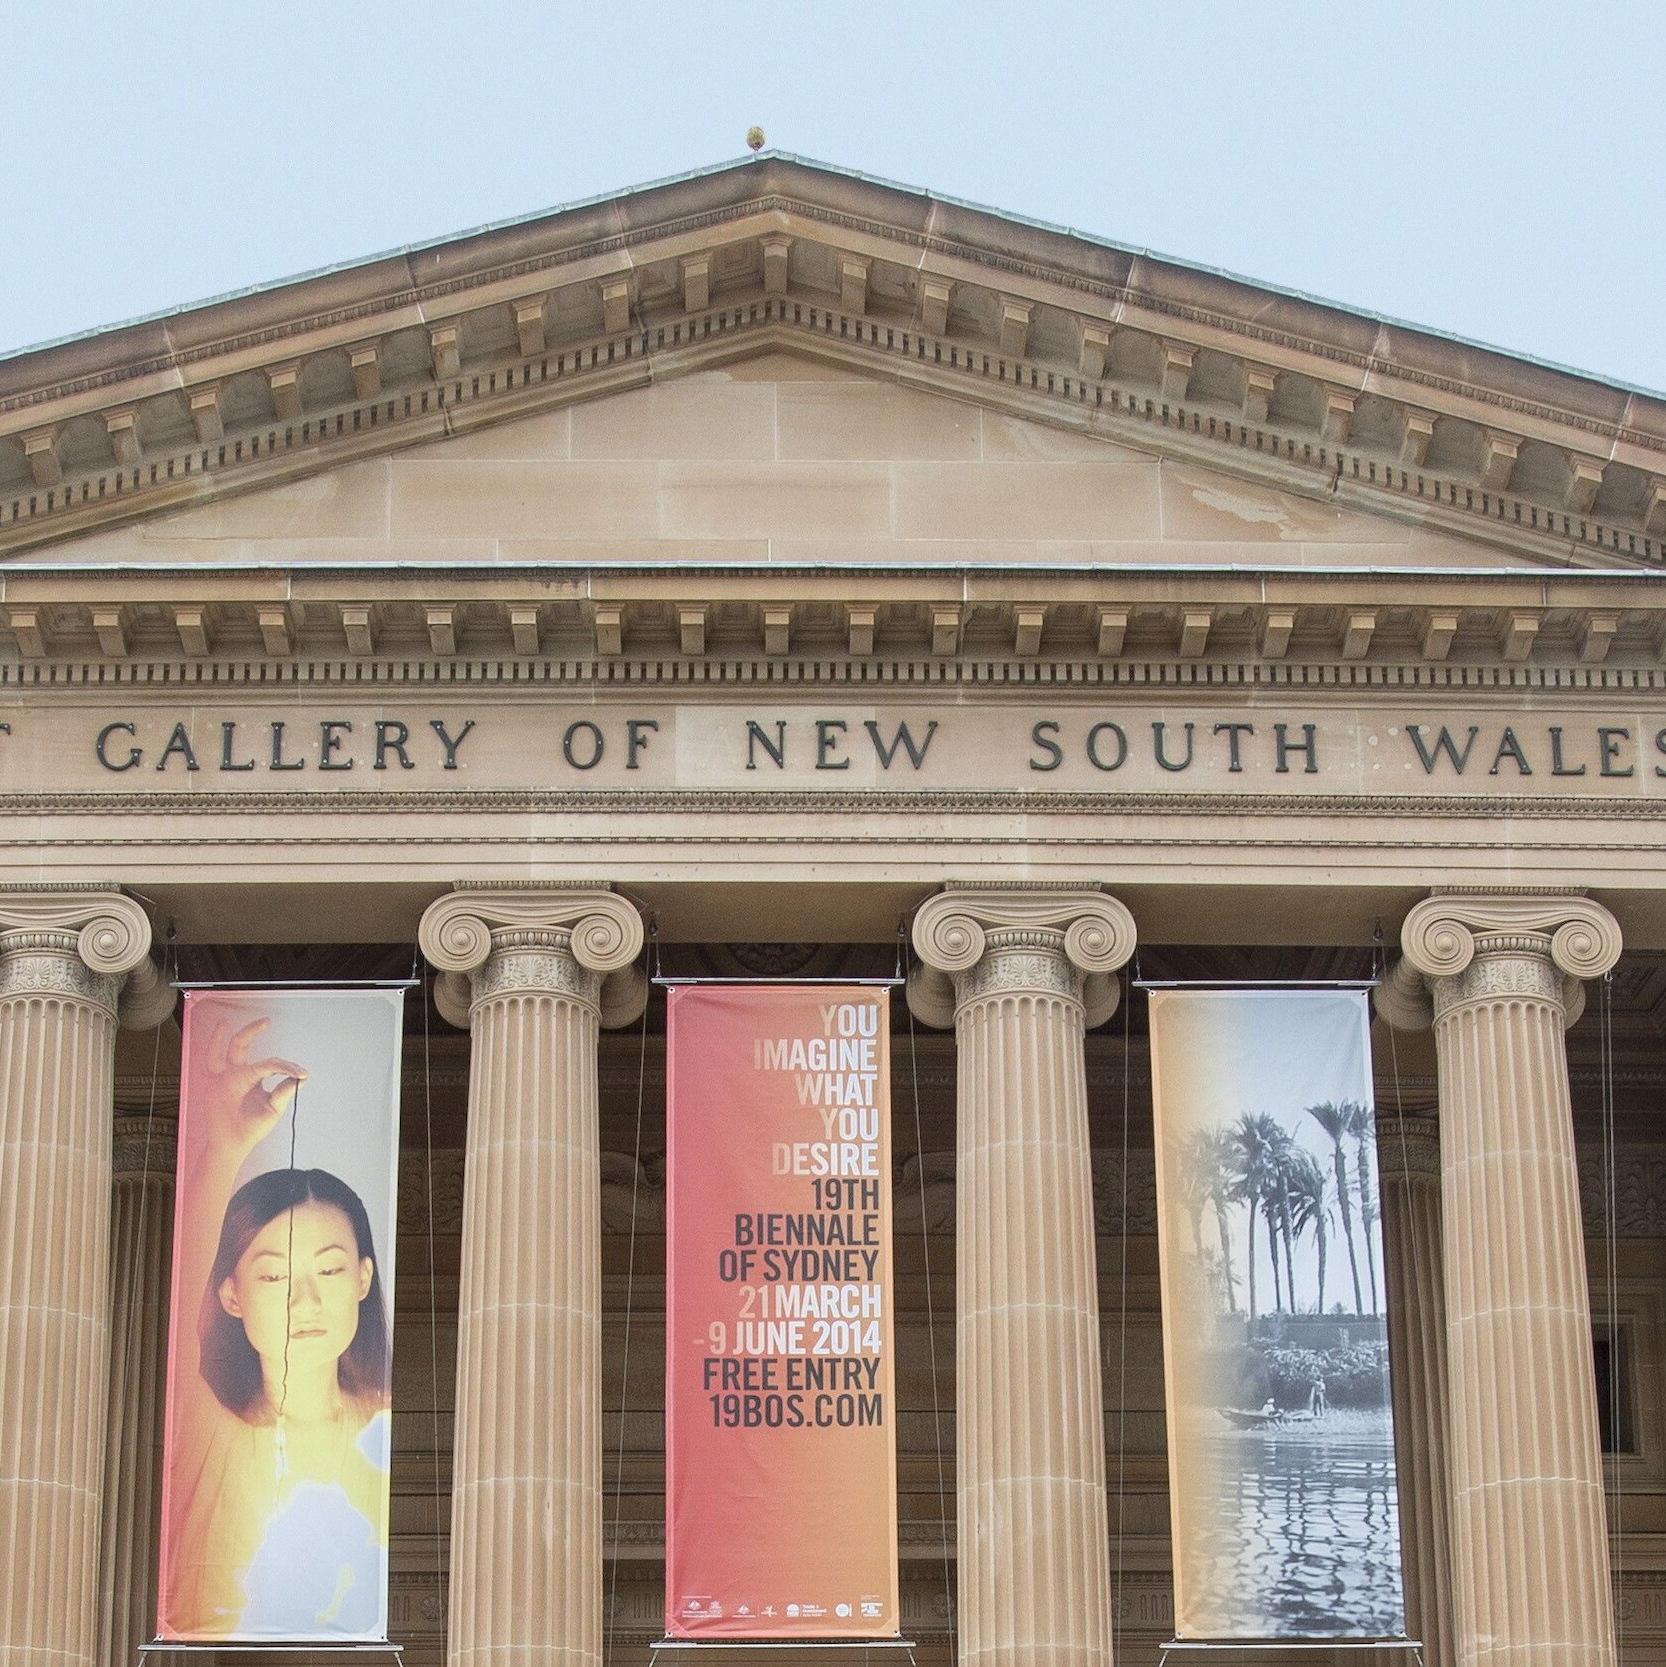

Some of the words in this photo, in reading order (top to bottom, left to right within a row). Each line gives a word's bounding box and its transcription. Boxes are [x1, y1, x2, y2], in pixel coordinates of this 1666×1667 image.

[96, 720, 475, 772] GALLERY
[562, 720, 659, 771] OF
[746, 719, 939, 771] NEW
[1029, 719, 1319, 773] SOUTH
[819, 1004, 877, 1037] YOU
[754, 1038, 878, 1071] IMAGINE
[794, 1073, 878, 1106] WHAT
[819, 1108, 879, 1141] YOU
[772, 1143, 879, 1176] DESIRE
[811, 1178, 879, 1211] 19TH
[735, 1213, 880, 1246] BIENNALE
[719, 1250, 757, 1283] OF
[763, 1249, 880, 1282] SYDNEY
[738, 1285, 769, 1319] 21
[775, 1284, 882, 1318] MARCH
[708, 1321, 727, 1355] 9
[733, 1321, 806, 1355] JUNE
[813, 1321, 882, 1355] 2014
[703, 1358, 778, 1391] FREE
[786, 1357, 881, 1391] ENTRY
[709, 1393, 883, 1428] 19BOS.COM
